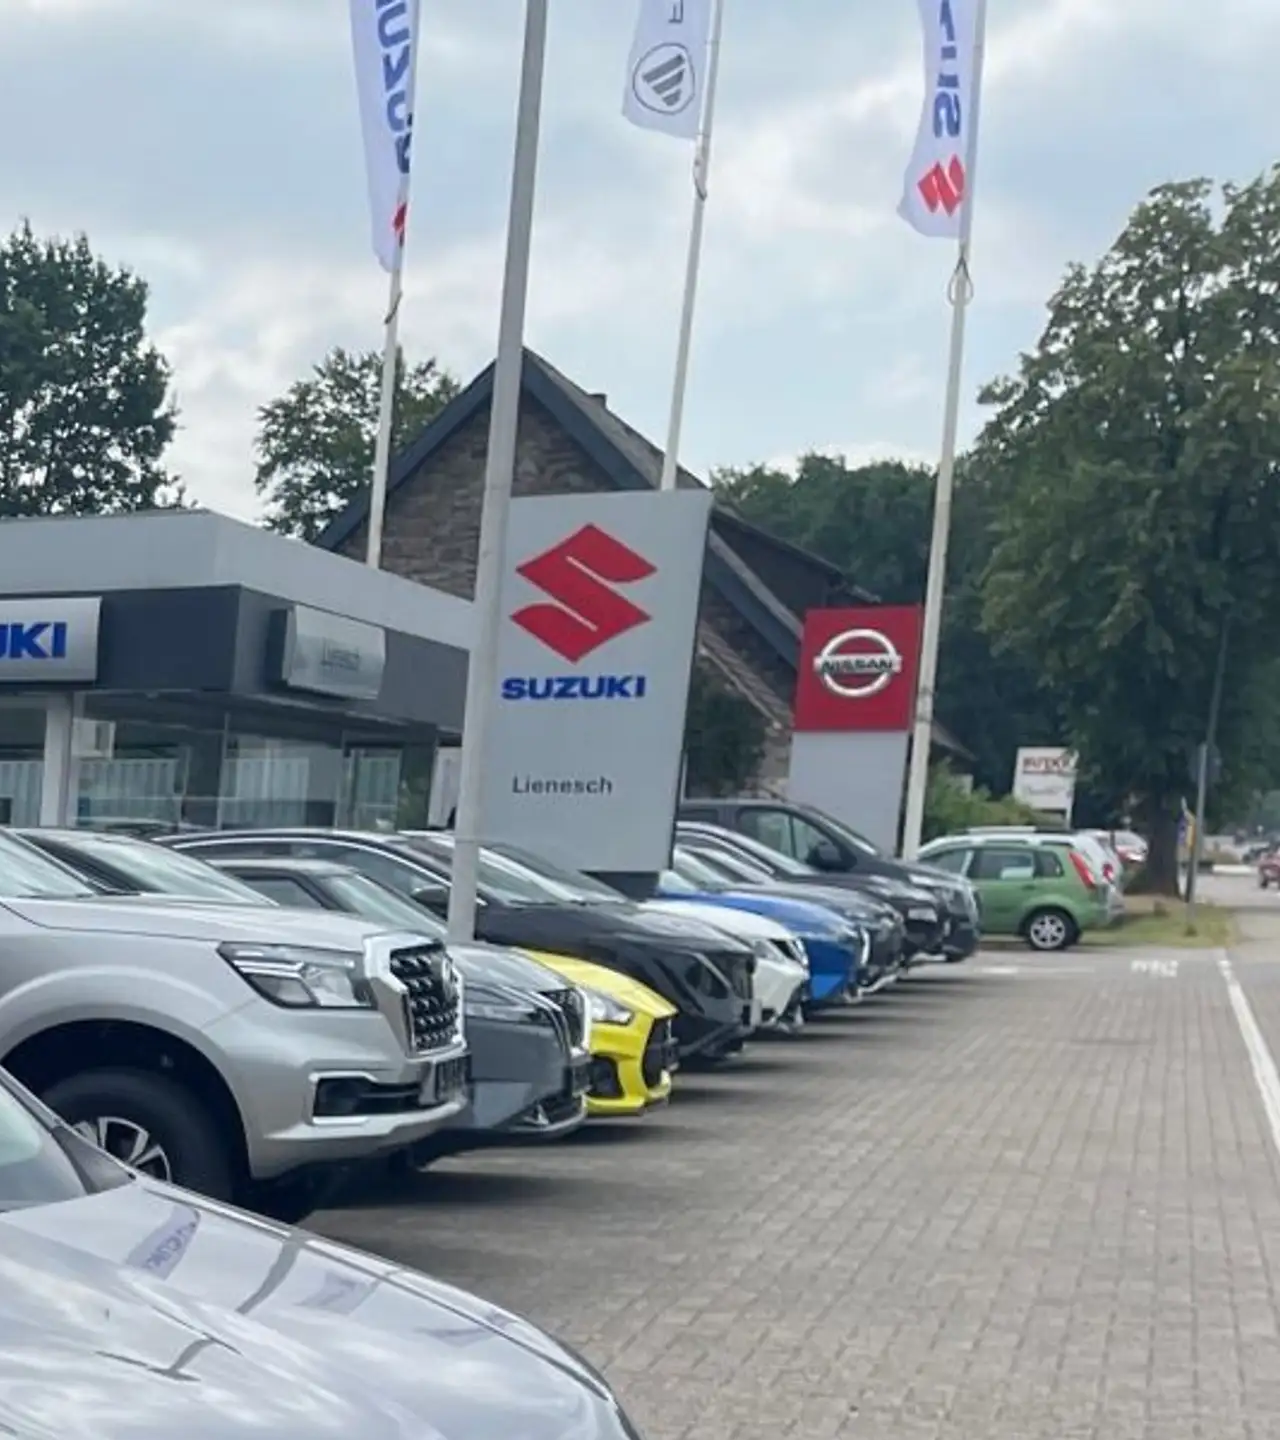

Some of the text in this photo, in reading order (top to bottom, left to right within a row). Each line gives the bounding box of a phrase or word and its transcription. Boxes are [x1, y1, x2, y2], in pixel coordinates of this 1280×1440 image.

[821, 657, 894, 674] NISSAN
[501, 675, 646, 700] SUZUKI
[512, 775, 613, 795] Lienesch
